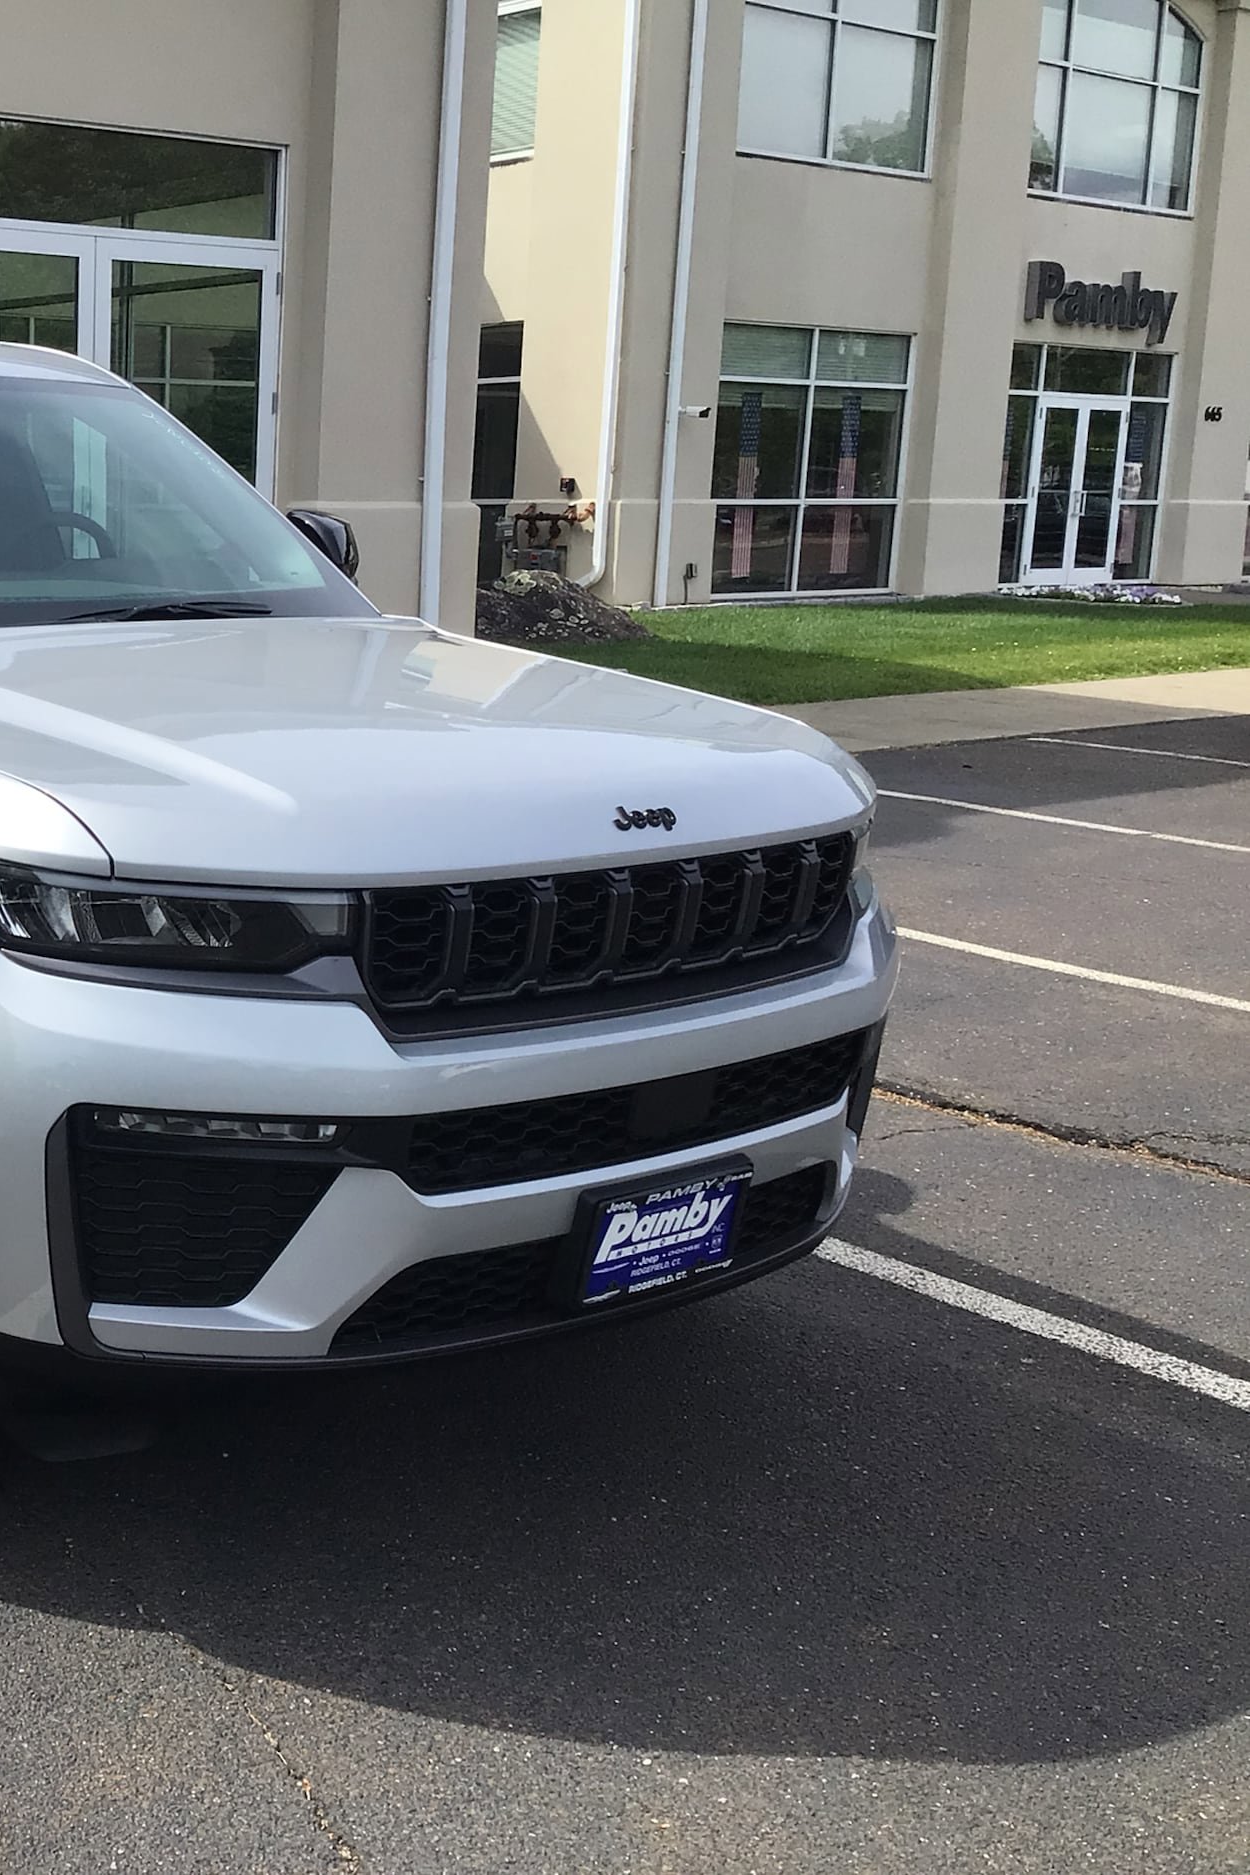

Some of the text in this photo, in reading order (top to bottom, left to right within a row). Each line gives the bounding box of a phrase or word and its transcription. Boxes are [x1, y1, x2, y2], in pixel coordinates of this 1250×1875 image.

[1024, 260, 1178, 346] Pamby
[613, 805, 677, 831] Jeep
[646, 1178, 718, 1204] PAMBY
[593, 1191, 733, 1265] Pamby
